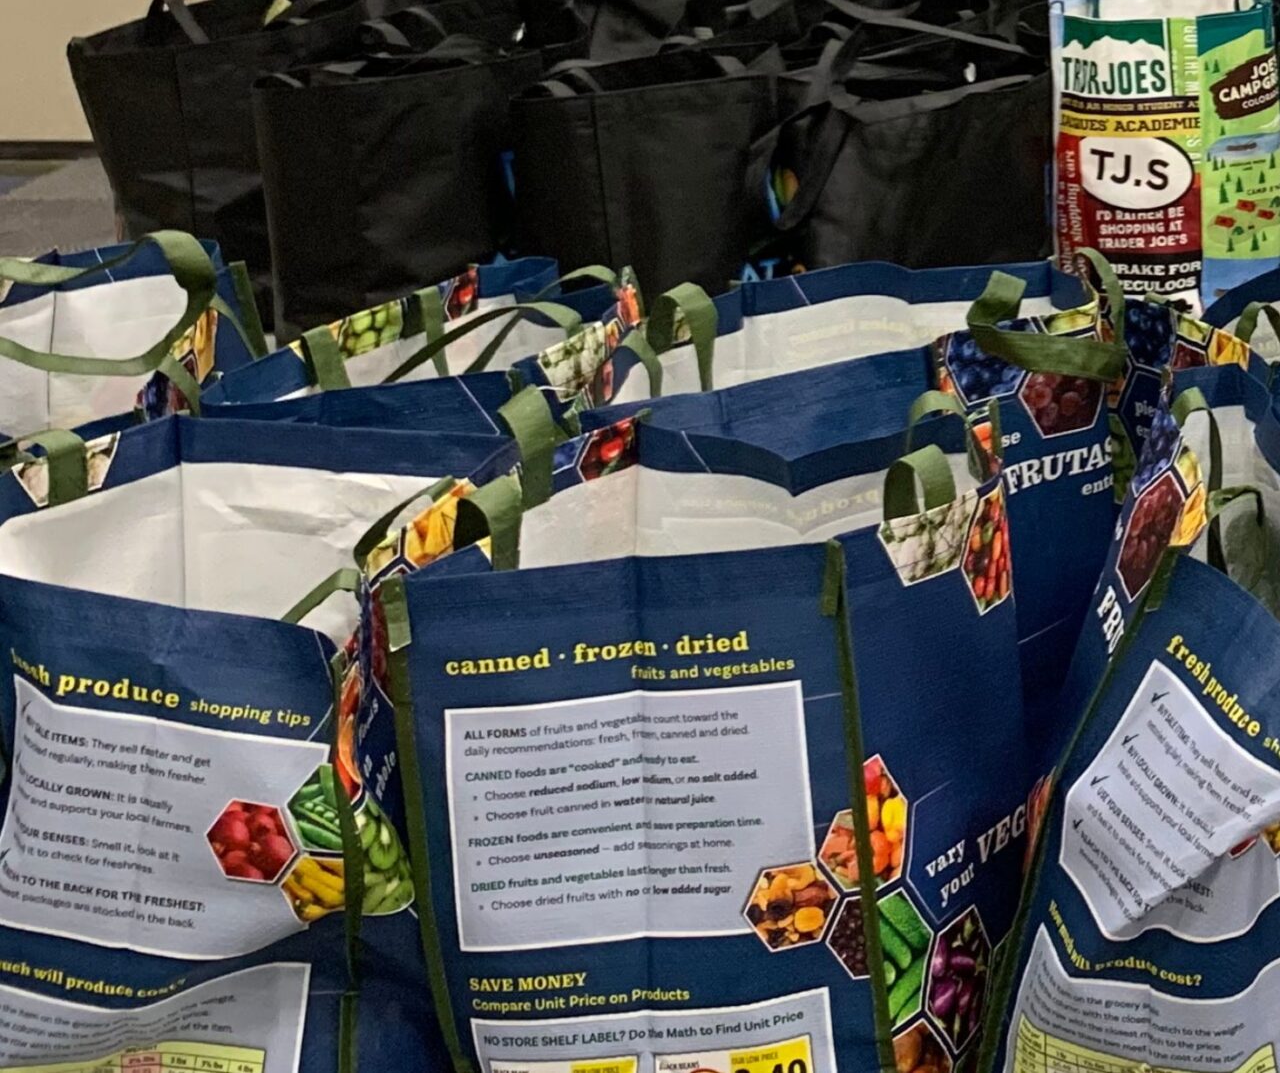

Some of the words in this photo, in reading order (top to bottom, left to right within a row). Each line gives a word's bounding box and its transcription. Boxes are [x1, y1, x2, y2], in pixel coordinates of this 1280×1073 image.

[1137, 101, 1185, 111] STUDENT
[1168, 206, 1185, 219] BE
[1099, 222, 1165, 235] SHOPPING
[1098, 237, 1145, 248] TRADER
[1149, 233, 1188, 247] JOE'S
[1168, 260, 1202, 275] FOR
[445, 647, 551, 676] canned
[574, 639, 657, 666] frozen
[675, 630, 750, 657] dried
[631, 665, 666, 680] fruits
[669, 664, 699, 680] and
[703, 657, 796, 681] vegetables
[1166, 634, 1214, 685] fresh
[1204, 673, 1261, 738] produce
[56, 675, 180, 709] produce
[189, 698, 273, 726] shopping
[276, 710, 312, 728] tips
[486, 726, 528, 741] FORMS
[92, 738, 118, 754] They
[465, 769, 513, 784] CANNED
[514, 766, 548, 780] foods
[467, 833, 515, 849] FROZEN
[571, 820, 634, 839] convenient
[924, 839, 966, 879] vary
[471, 878, 507, 893] DRIED
[563, 867, 626, 885] vegetables
[939, 863, 975, 908] your
[96, 888, 119, 901] FOR
[34, 968, 64, 985] will
[66, 977, 134, 998] produce
[469, 976, 515, 993] SAVE
[517, 972, 588, 992] MONEY
[1160, 969, 1203, 987] cost?
[472, 998, 533, 1015] Compare
[535, 994, 568, 1011] Unit
[569, 992, 606, 1008] Price
[609, 992, 629, 1004] on
[631, 987, 691, 1003] Products
[484, 1035, 501, 1047] NO
[502, 1035, 540, 1048] STORE
[541, 1032, 580, 1047] SHELF
[581, 1031, 627, 1045] LABEL?
[629, 1028, 647, 1040] Do
[666, 1024, 699, 1039] Math
[700, 1024, 712, 1036] to
[715, 1019, 742, 1034] Find
[744, 1016, 771, 1032] Unit
[773, 1009, 805, 1028] Price
